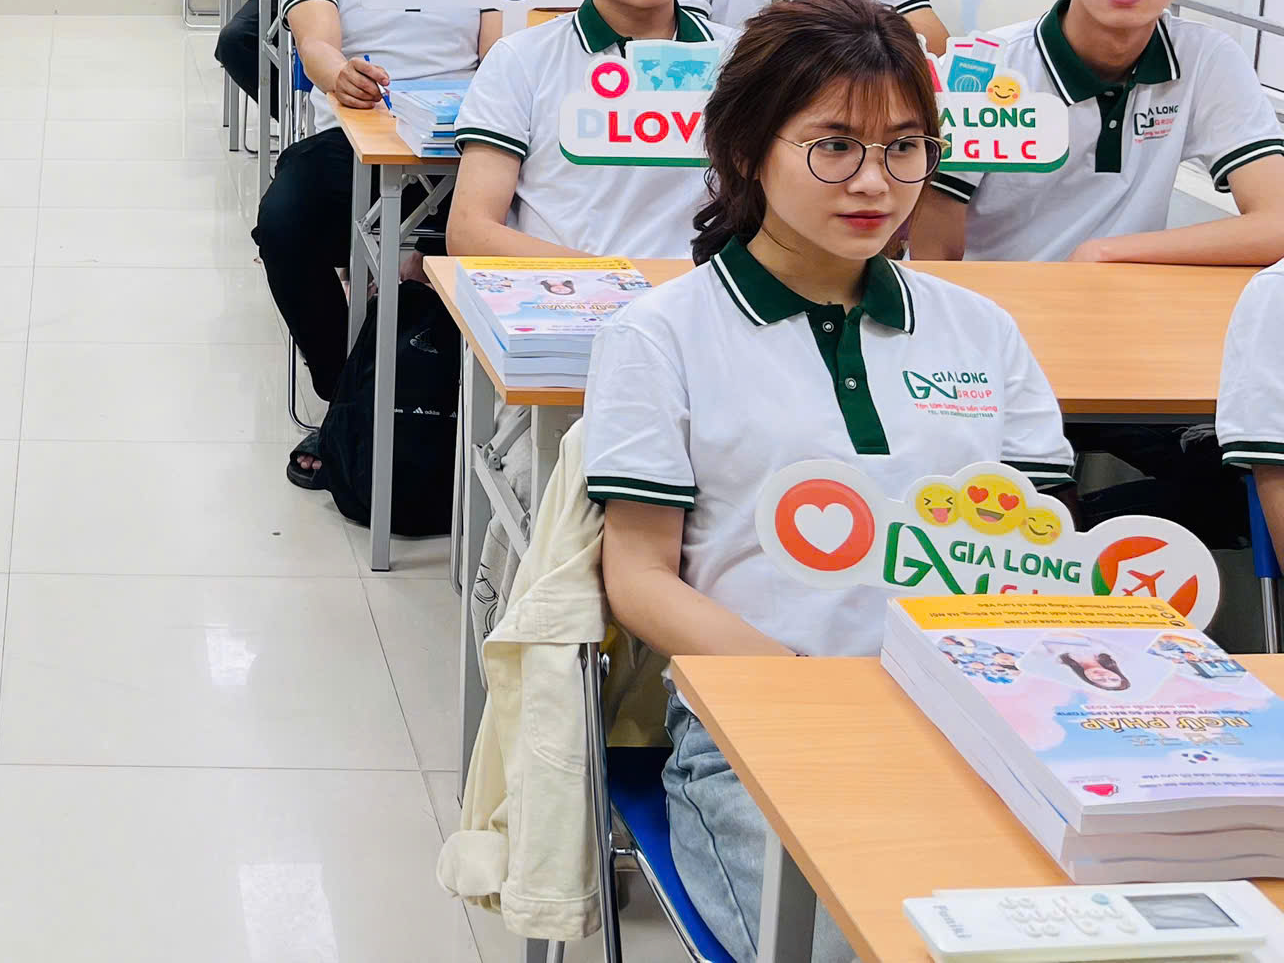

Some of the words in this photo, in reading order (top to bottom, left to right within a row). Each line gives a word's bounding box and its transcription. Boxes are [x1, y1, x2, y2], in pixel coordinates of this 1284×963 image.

[963, 107, 1036, 128] LONG
[608, 110, 703, 144] LOV
[955, 372, 988, 383] LONG
[949, 540, 996, 569] GIA
[1003, 548, 1082, 584] LONG
[1080, 717, 1170, 733] PHÁP
[1176, 717, 1252, 732] NGỮ
